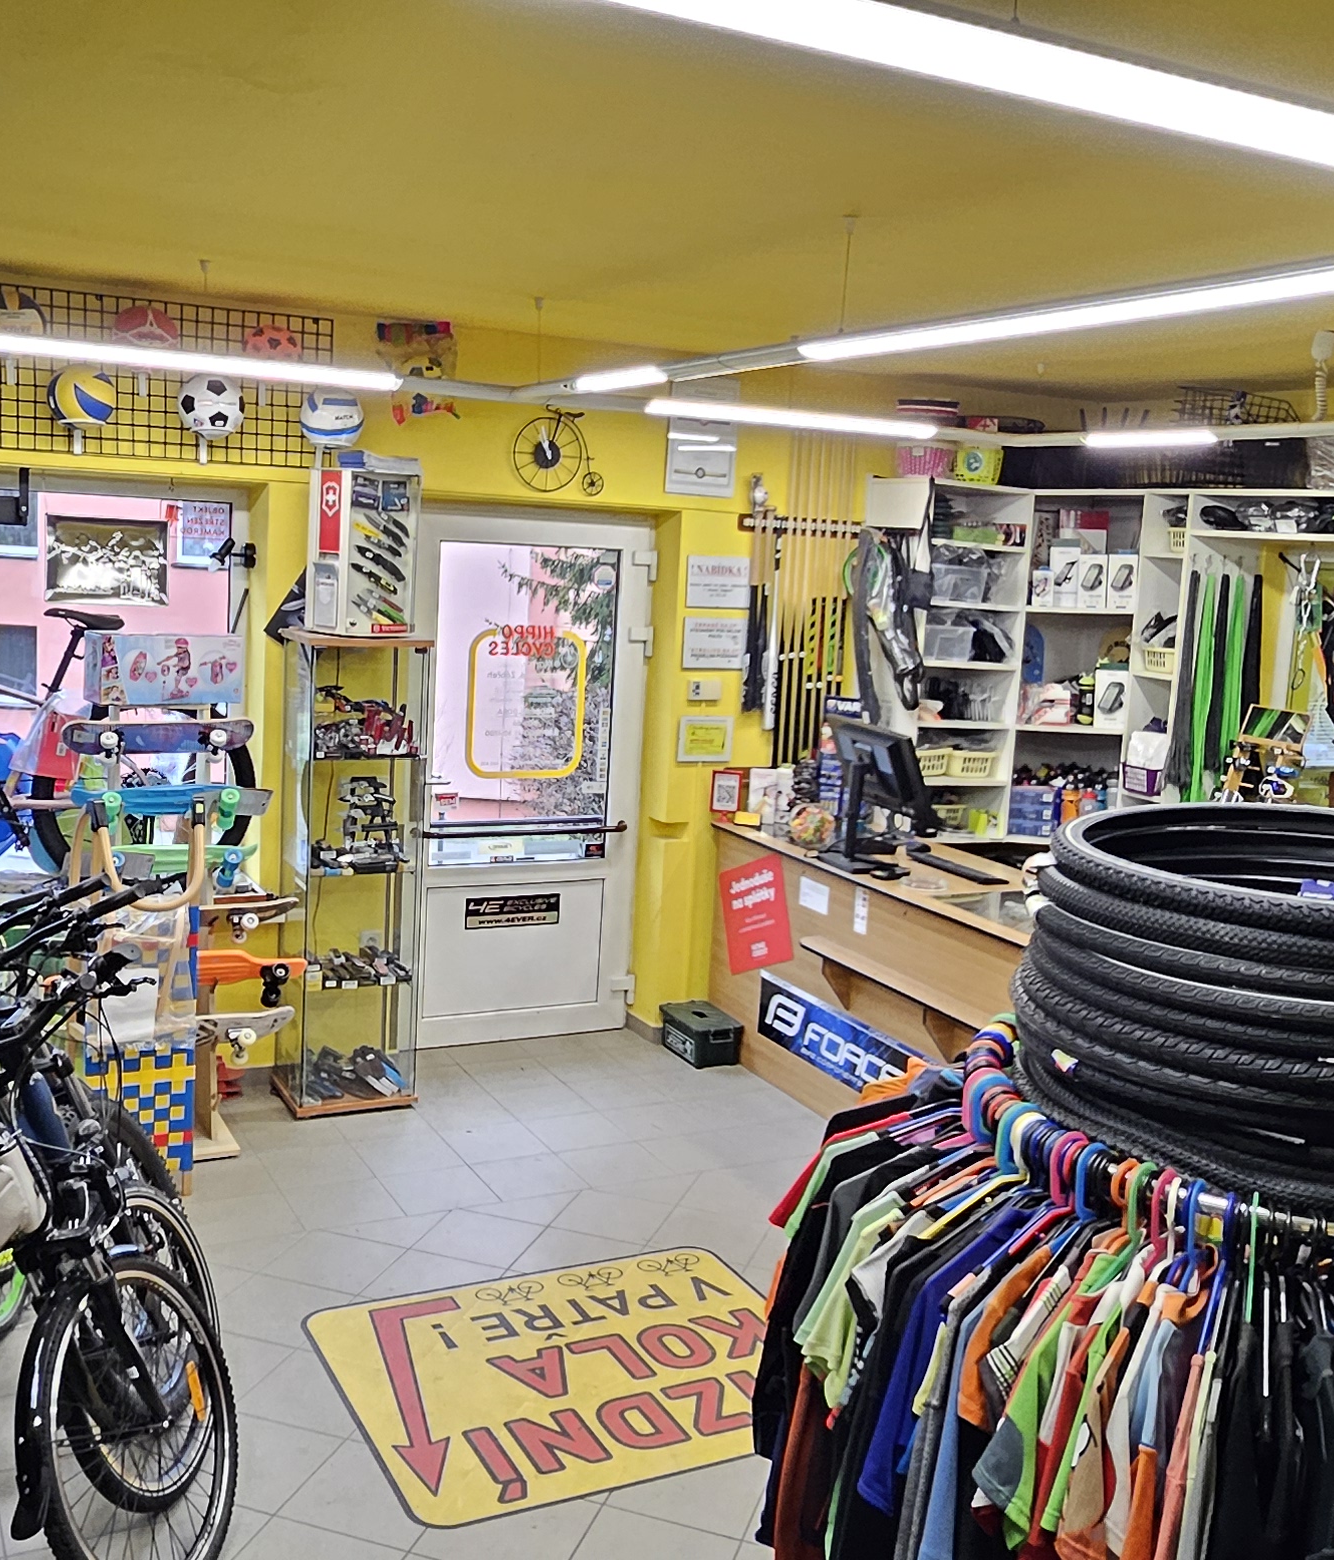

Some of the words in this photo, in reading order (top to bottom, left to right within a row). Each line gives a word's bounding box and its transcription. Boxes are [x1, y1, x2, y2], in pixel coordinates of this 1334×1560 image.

[469, 1283, 678, 1344] PATŘE
[692, 1275, 733, 1302] V
[486, 1308, 769, 1399] KOLA
[461, 1372, 755, 1505] ZDNÍ
